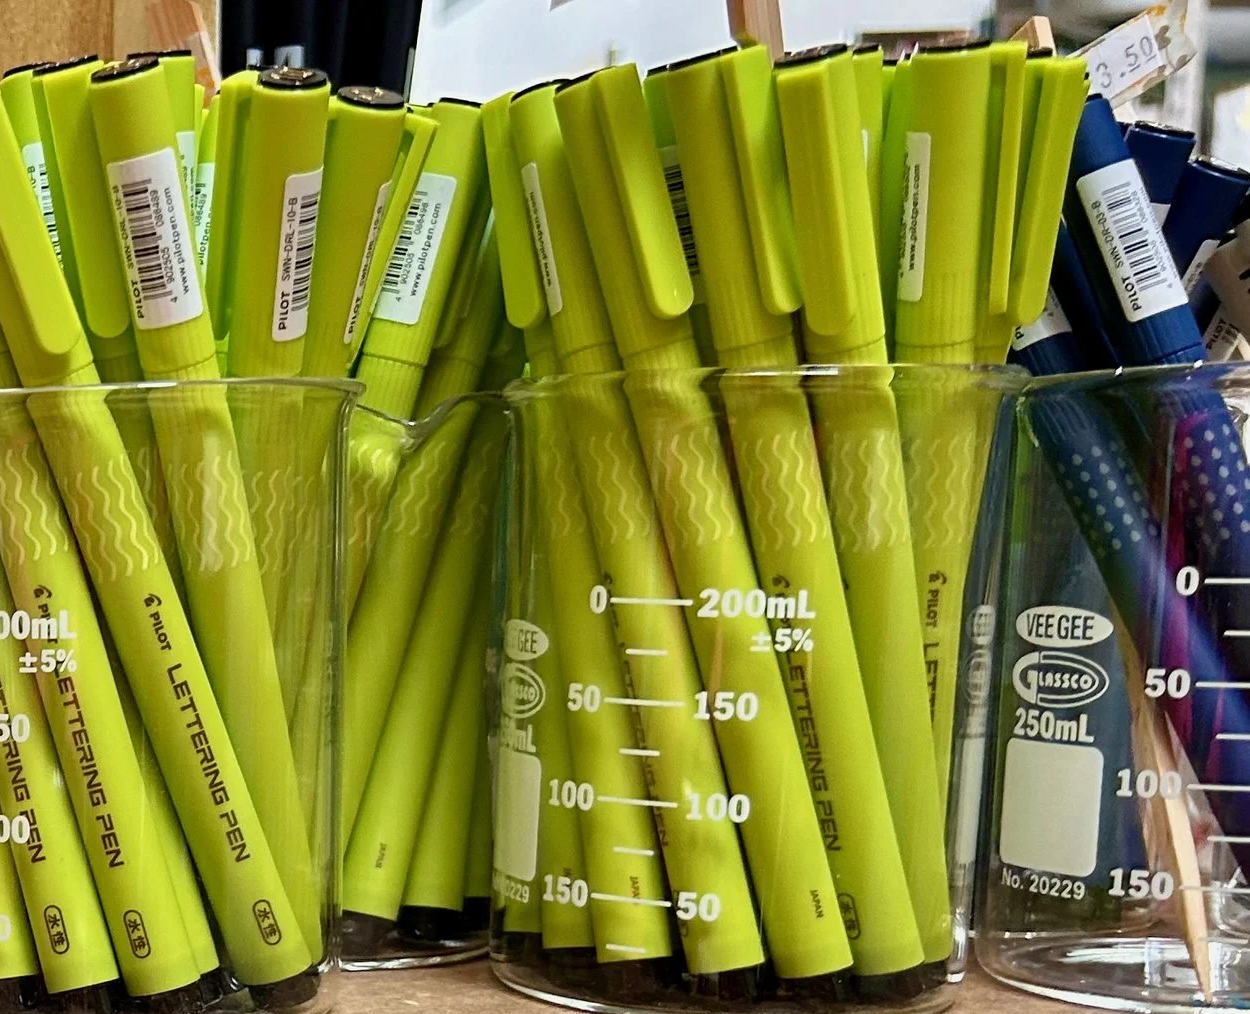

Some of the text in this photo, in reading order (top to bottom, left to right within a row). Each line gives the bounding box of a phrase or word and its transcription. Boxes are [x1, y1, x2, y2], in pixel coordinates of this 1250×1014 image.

[163, 187, 190, 295] www.pilotpen.com
[410, 202, 442, 297] www.pilotpen.com
[278, 197, 298, 331] PILOT SWN-DRL-10-B
[131, 279, 144, 319] PILOT
[1121, 276, 1142, 312] PILOT
[348, 297, 362, 334] PILOT
[1175, 566, 1199, 597] 0
[590, 586, 816, 619] 0 200mL
[925, 590, 940, 627] PILOT
[751, 629, 814, 653] ±5%
[1025, 612, 1095, 641] VEE GEE
[18, 649, 77, 673] ±5%
[1145, 668, 1191, 699] 50
[568, 684, 601, 712] 50
[694, 691, 759, 721] 150
[150, 612, 250, 864] PILOT LETTERING PEN
[1014, 708, 1094, 743] 250mL
[1115, 768, 1183, 798] 100
[550, 780, 750, 824] 100 100
[19, 809, 46, 864] PEN
[96, 813, 125, 868] PEN
[814, 803, 841, 852] PEN
[543, 875, 720, 921] 150 50
[1002, 868, 1086, 899] No. 20229
[1108, 867, 1174, 900] 150
[809, 890, 824, 919] JAPAN
[48, 913, 65, 947] 水性
[128, 917, 146, 953] 水性
[258, 907, 277, 940] 水性
